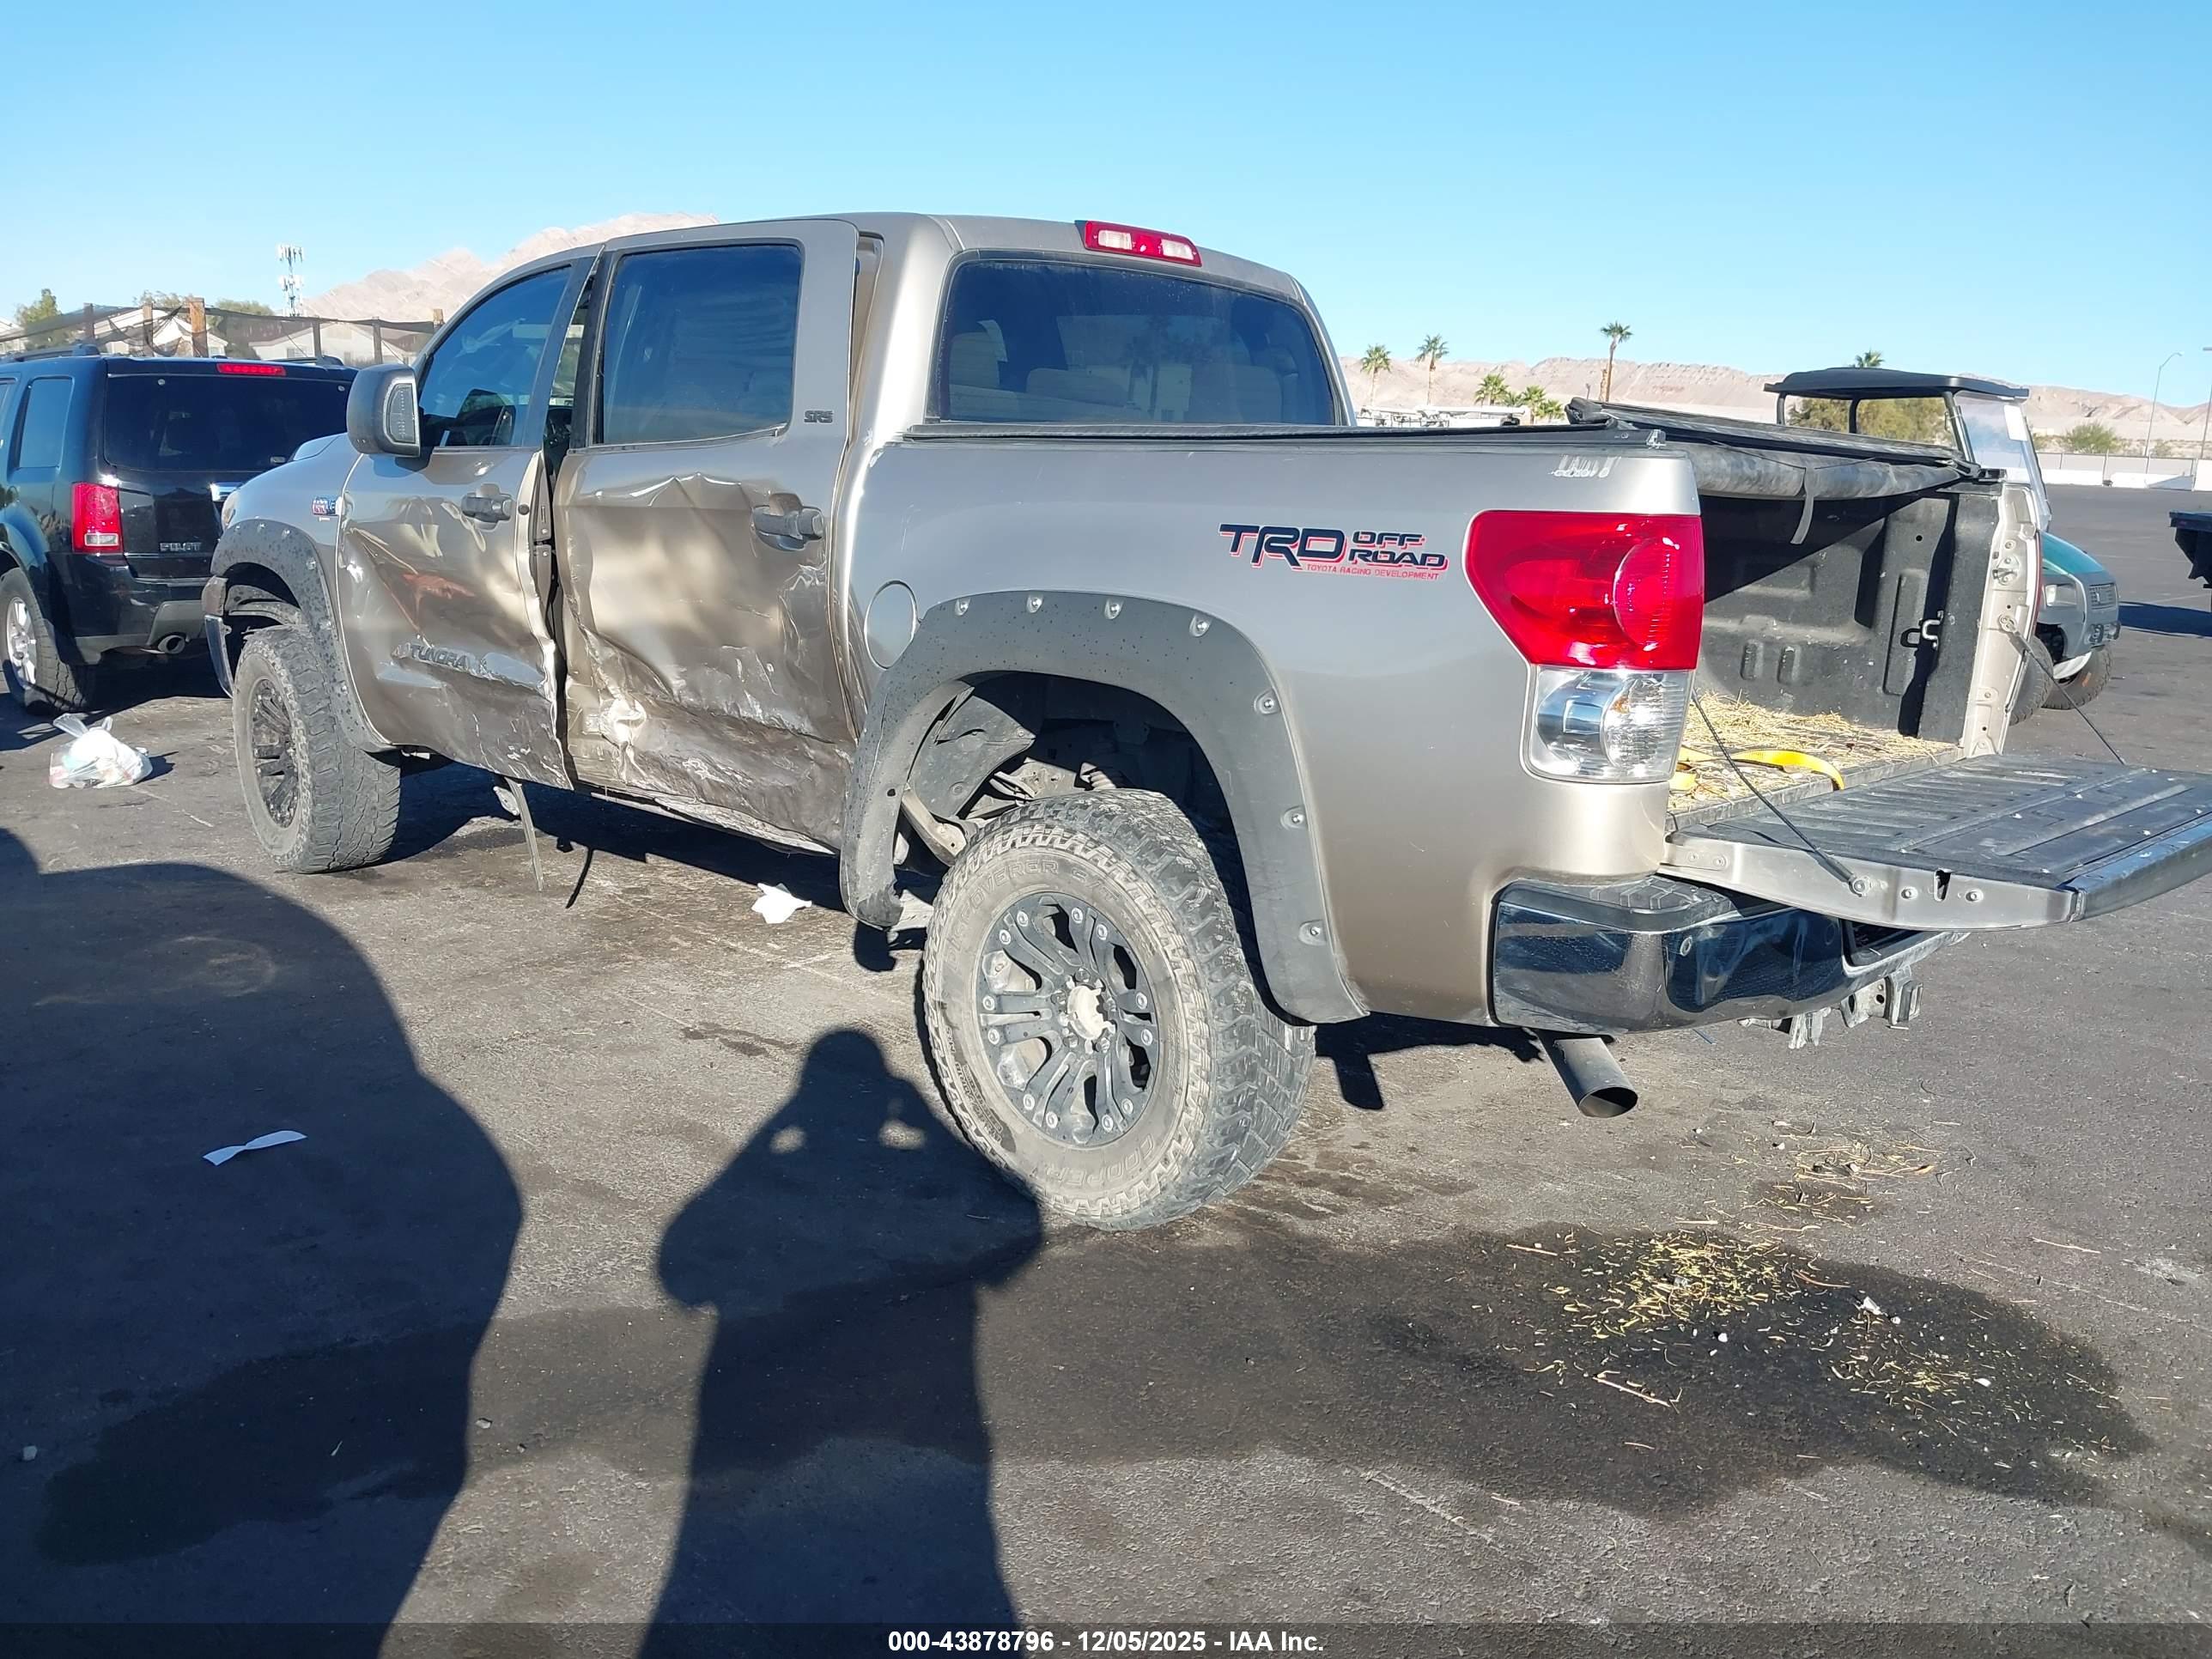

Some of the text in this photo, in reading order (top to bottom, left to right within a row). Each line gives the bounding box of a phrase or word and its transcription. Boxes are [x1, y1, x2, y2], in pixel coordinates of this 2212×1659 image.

[1218, 523, 1346, 568] TRD
[1352, 531, 1425, 549] OFF
[1348, 549, 1448, 570] ROAD
[1306, 563, 1440, 581] TOYOTA RACING DEVELOPMENT
[410, 644, 468, 669] TUNDRA
